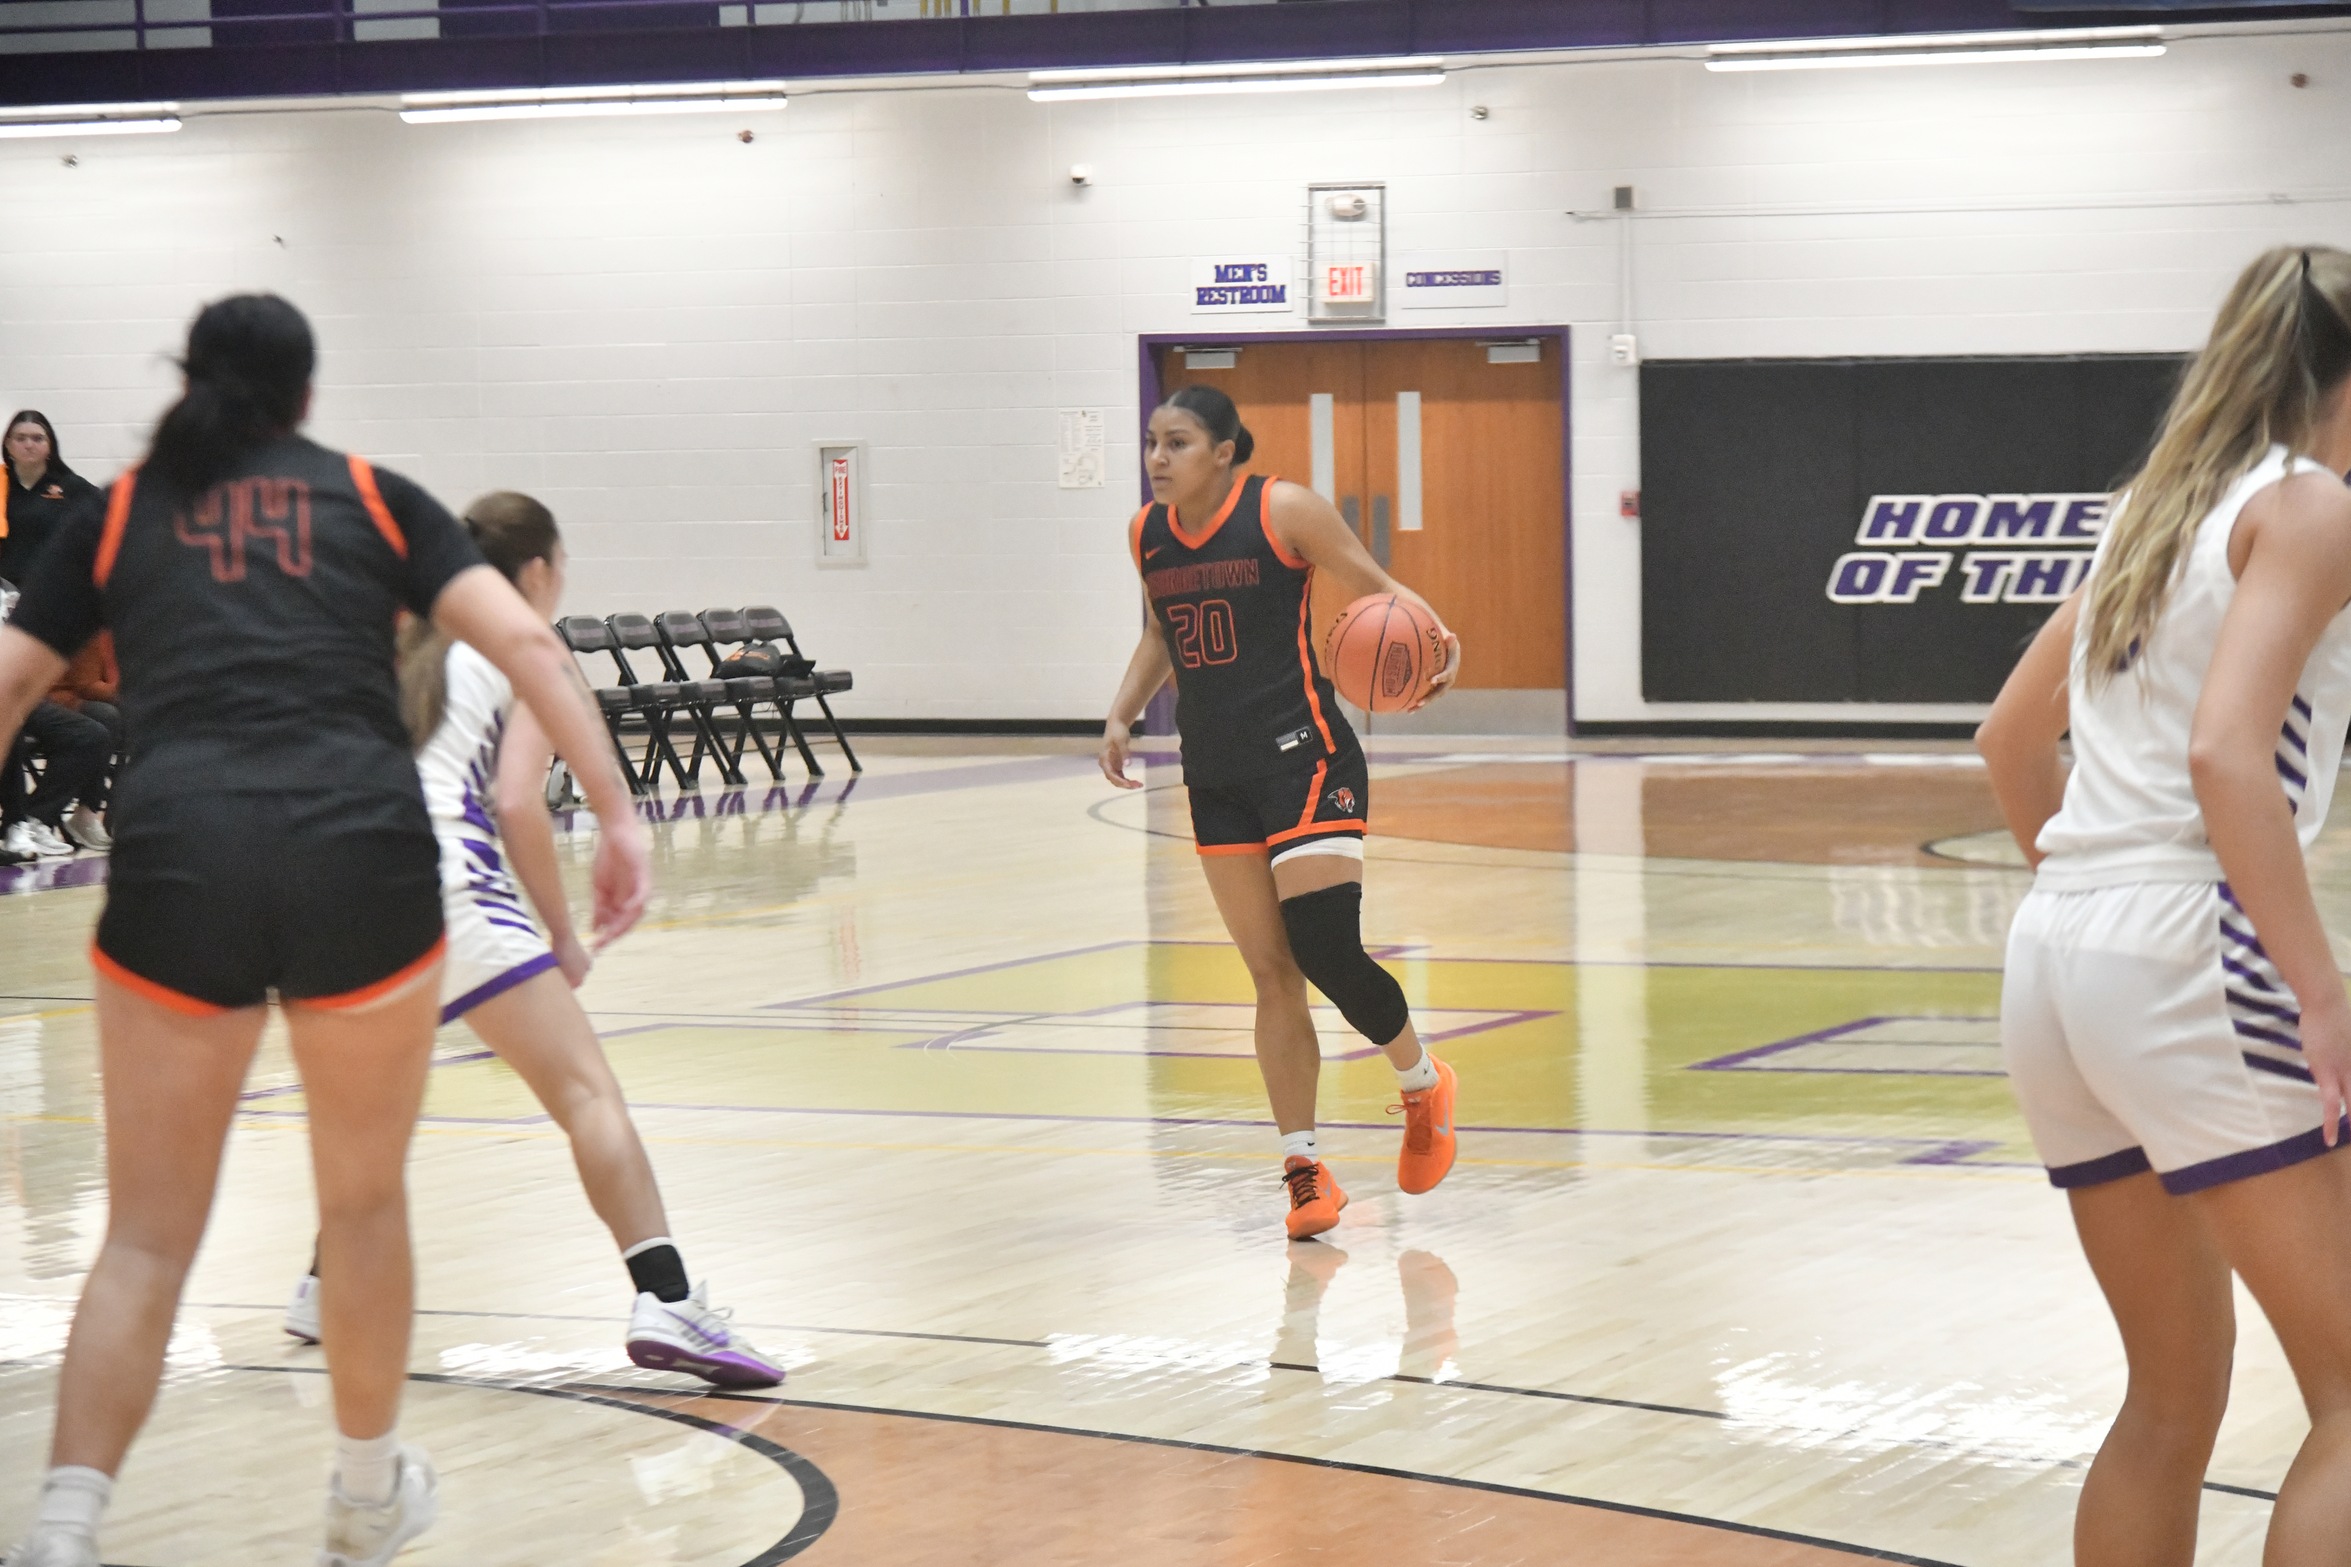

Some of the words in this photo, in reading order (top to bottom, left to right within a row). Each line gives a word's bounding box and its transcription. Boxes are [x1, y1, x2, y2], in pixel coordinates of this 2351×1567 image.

[1214, 263, 1267, 283] MEN'S
[1329, 267, 1363, 295] EXIT
[1406, 270, 1501, 287] CONCESSIONS
[1196, 285, 1286, 305] RESTROOM
[173, 475, 314, 583] 44
[1855, 493, 2116, 545] HOME
[1826, 552, 1953, 603] OF
[1167, 599, 1238, 668] 20
